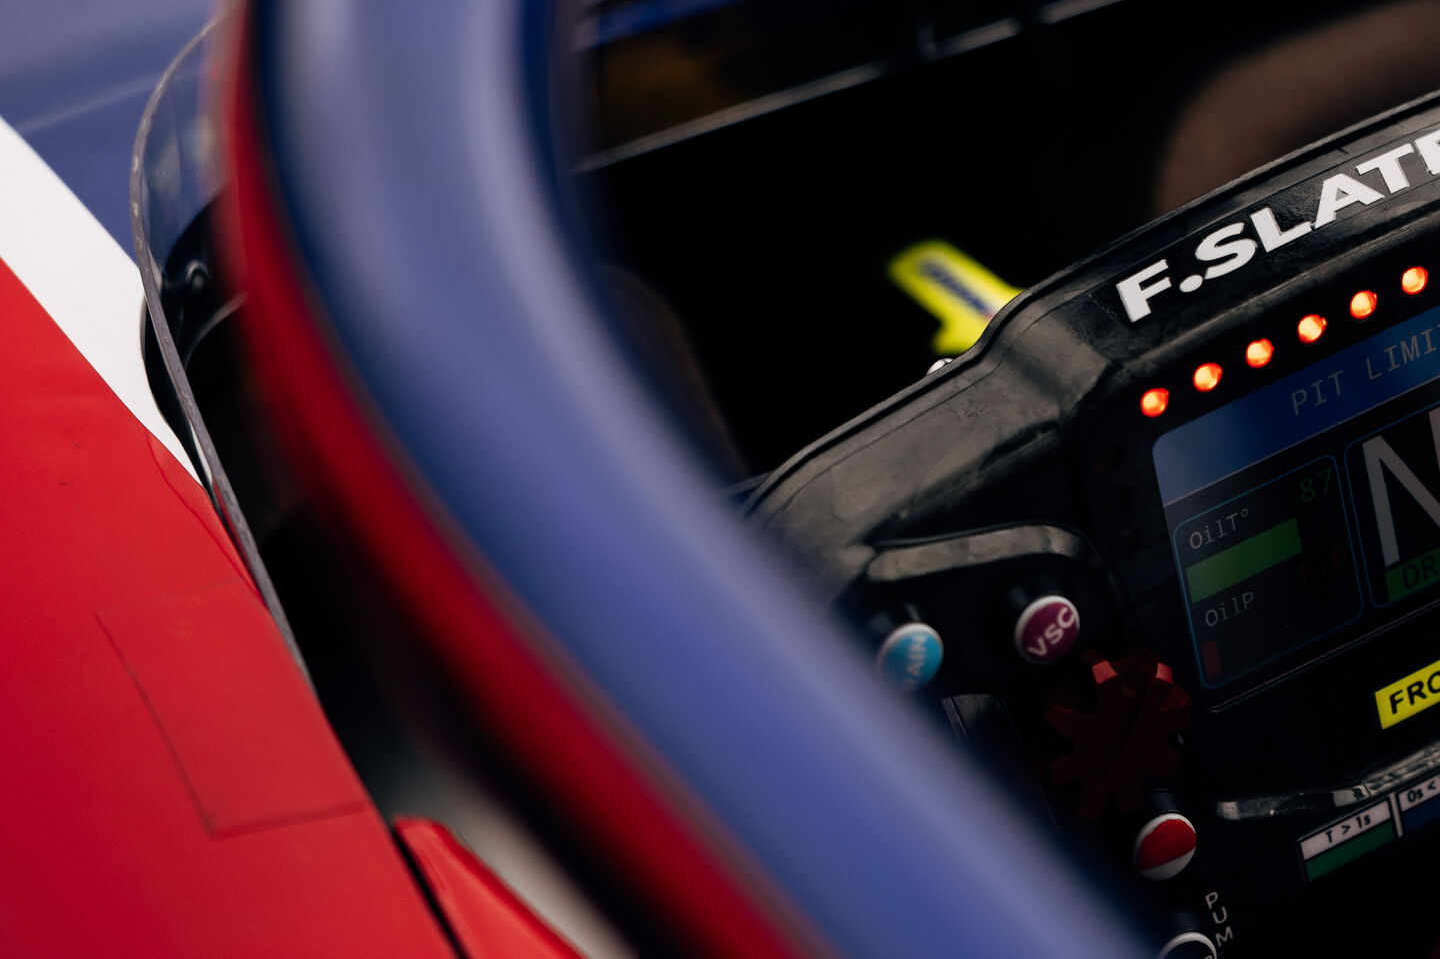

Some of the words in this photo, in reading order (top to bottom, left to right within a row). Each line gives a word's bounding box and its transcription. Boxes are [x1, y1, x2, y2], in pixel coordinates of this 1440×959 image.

[1290, 370, 1345, 415] PIT
[1299, 467, 1333, 504] 87
[1204, 590, 1255, 628] OilP
[1027, 606, 1077, 659] VSC
[1406, 788, 1425, 804] 0s
[1355, 813, 1372, 830] 1s
[1205, 891, 1235, 957] PUM
